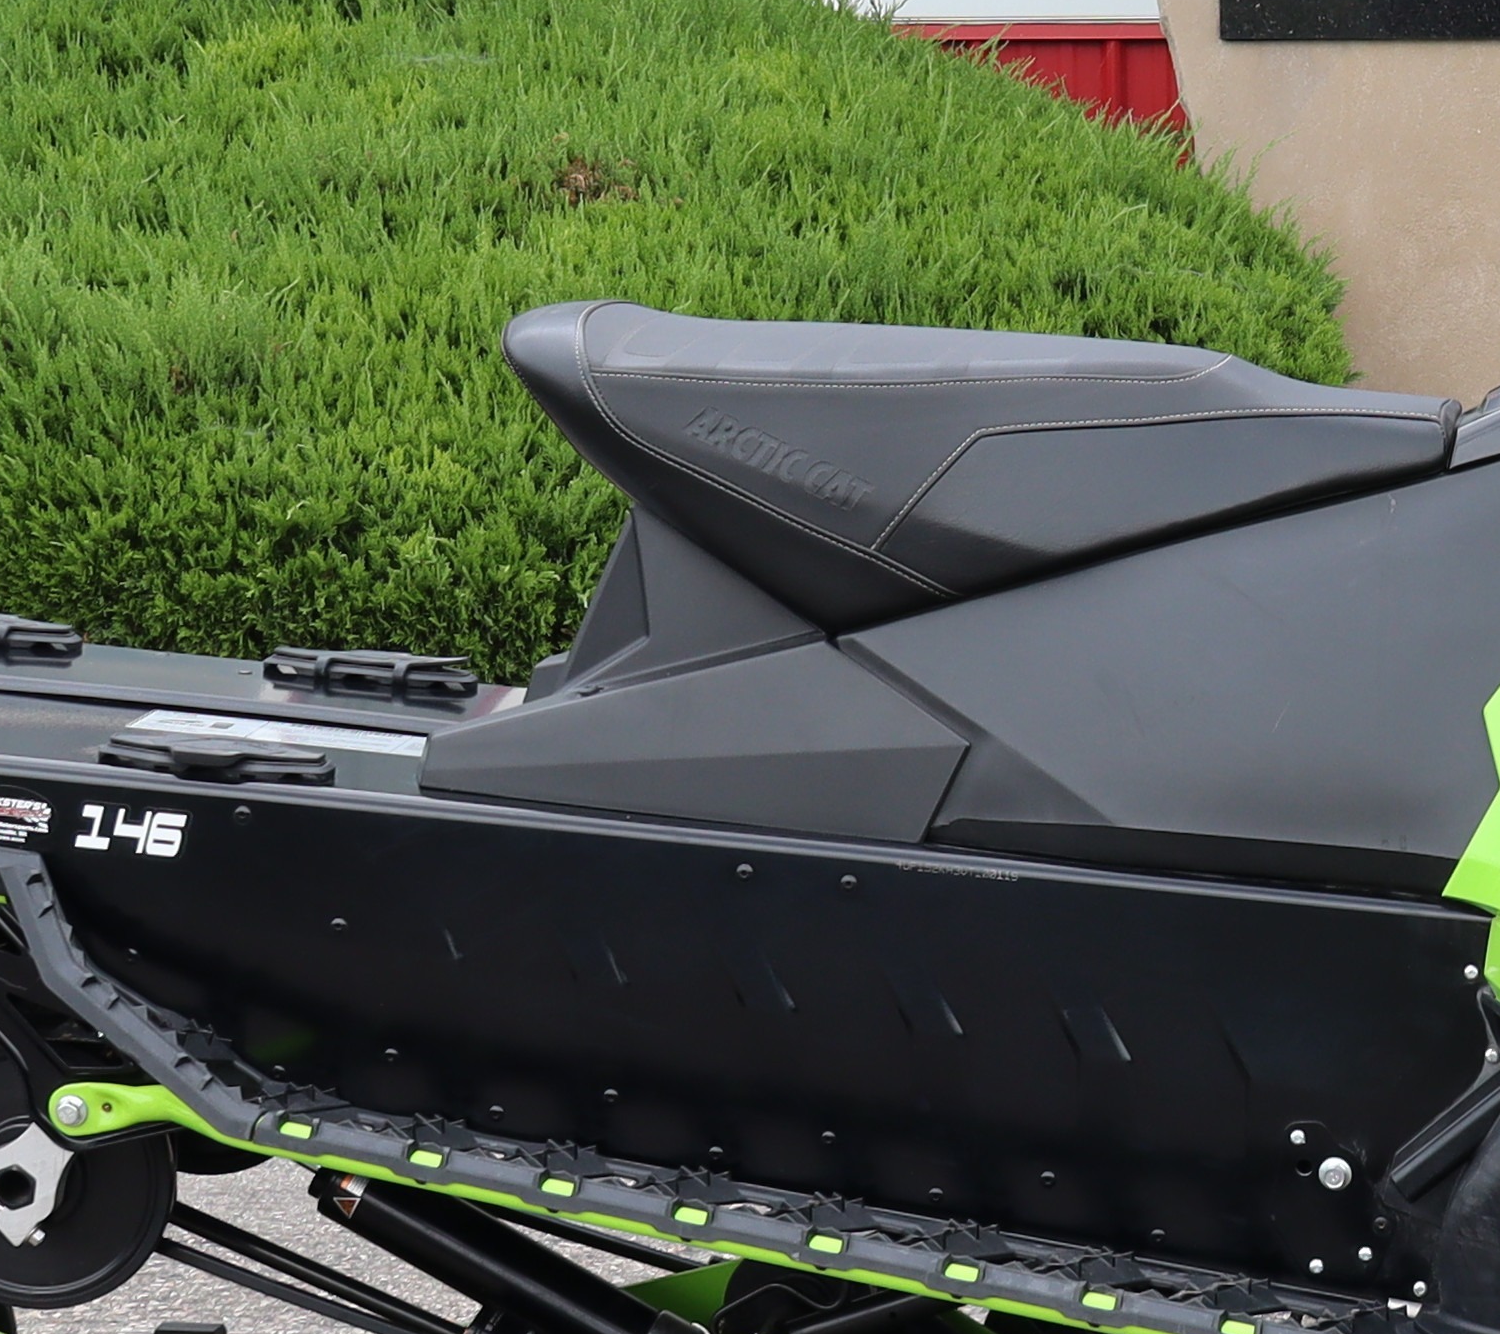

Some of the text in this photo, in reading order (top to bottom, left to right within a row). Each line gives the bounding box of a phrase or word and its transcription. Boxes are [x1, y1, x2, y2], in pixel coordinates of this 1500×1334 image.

[683, 406, 884, 511] ARCTIC CAT
[74, 804, 188, 857] 146
